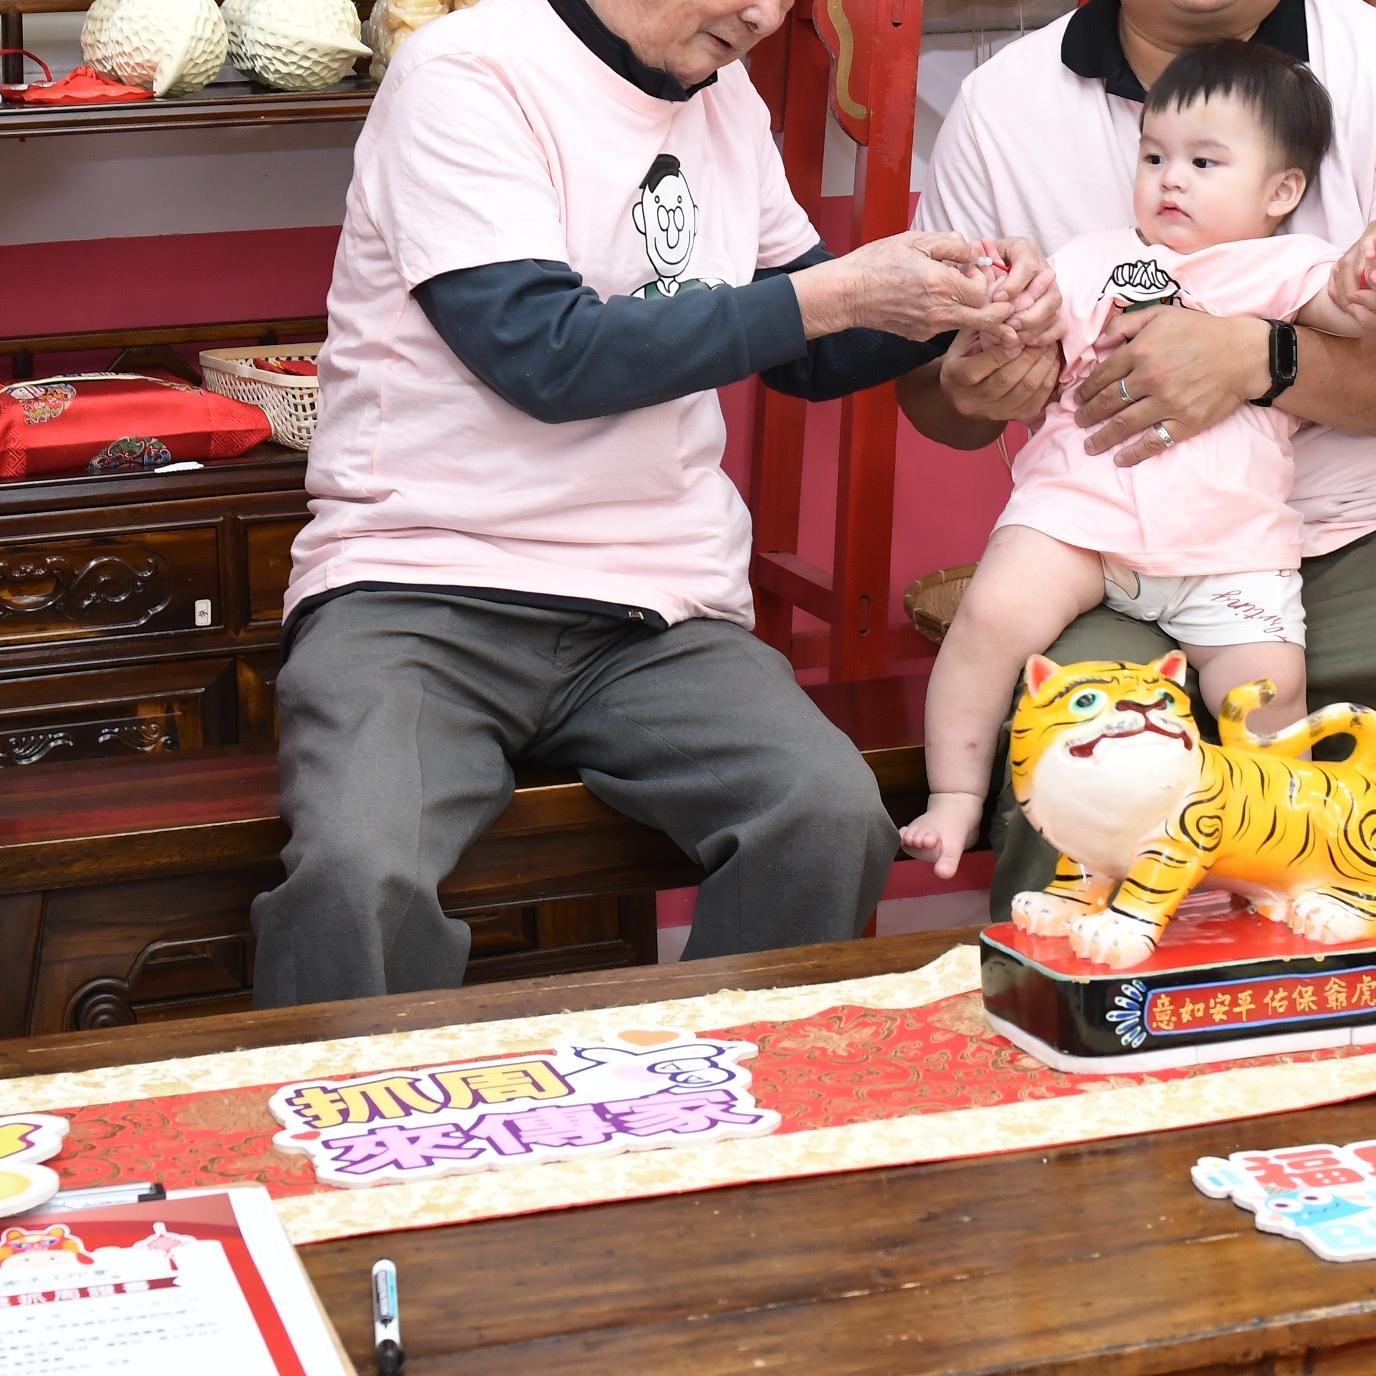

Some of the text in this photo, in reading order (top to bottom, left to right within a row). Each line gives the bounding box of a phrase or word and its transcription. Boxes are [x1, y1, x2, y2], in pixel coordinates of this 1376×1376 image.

[287, 1058, 576, 1129] 抓周
[322, 1090, 764, 1175] 來傳家
